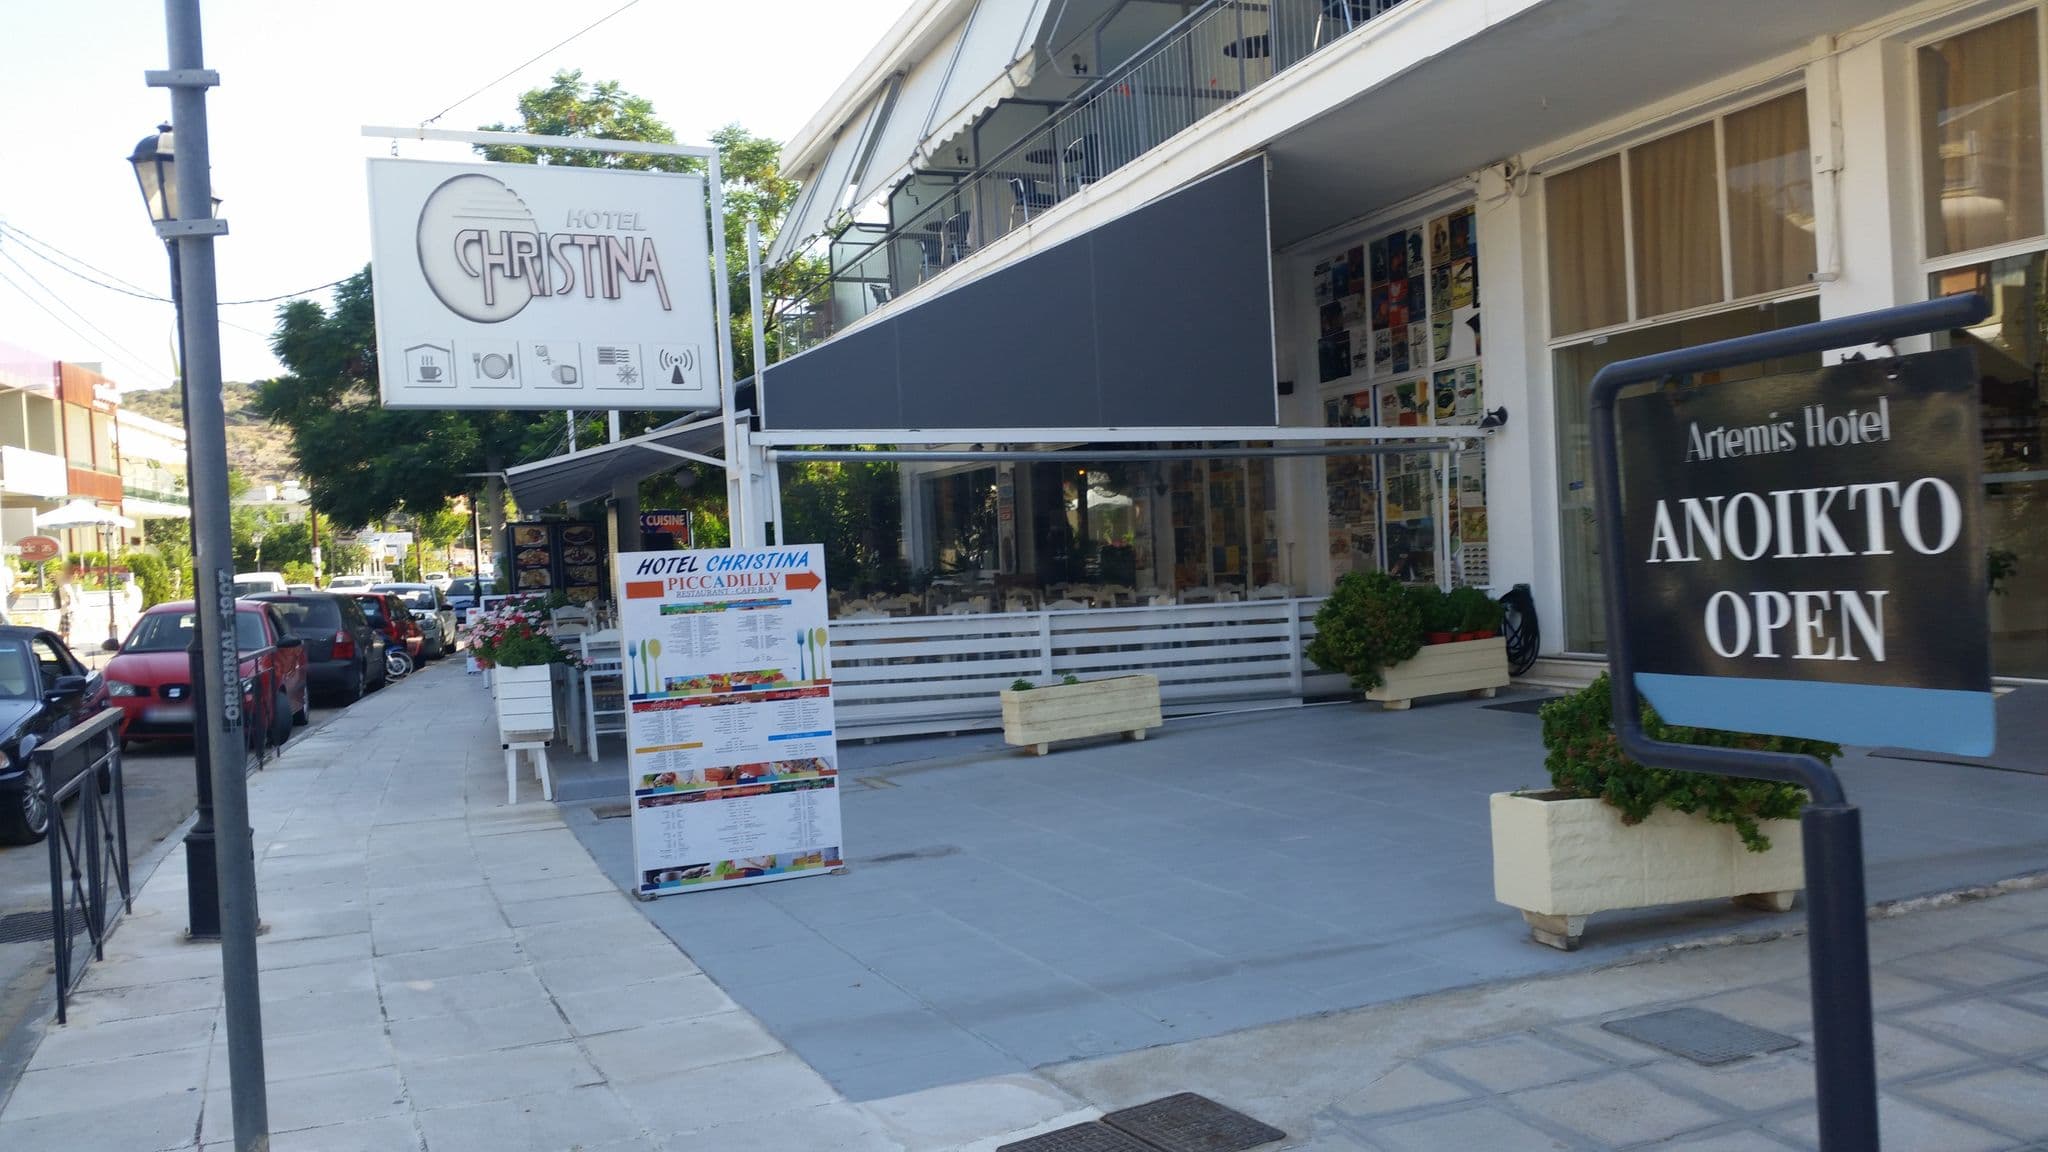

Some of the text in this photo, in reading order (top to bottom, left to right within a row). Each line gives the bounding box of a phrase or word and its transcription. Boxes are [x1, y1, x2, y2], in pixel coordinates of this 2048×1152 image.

[566, 208, 648, 232] HOTEL
[454, 229, 672, 311] CHRISTINA
[1686, 396, 1891, 463] Artemis Hotel
[646, 514, 685, 526] CUISINE
[636, 551, 809, 575] HOTEL CHRISTINA
[668, 572, 780, 590] PICCADILLY
[676, 588, 729, 598] RESTAURANT
[757, 586, 774, 594] BAR
[1704, 590, 1889, 662] OPEN
[221, 624, 240, 720] ORIGINAL
